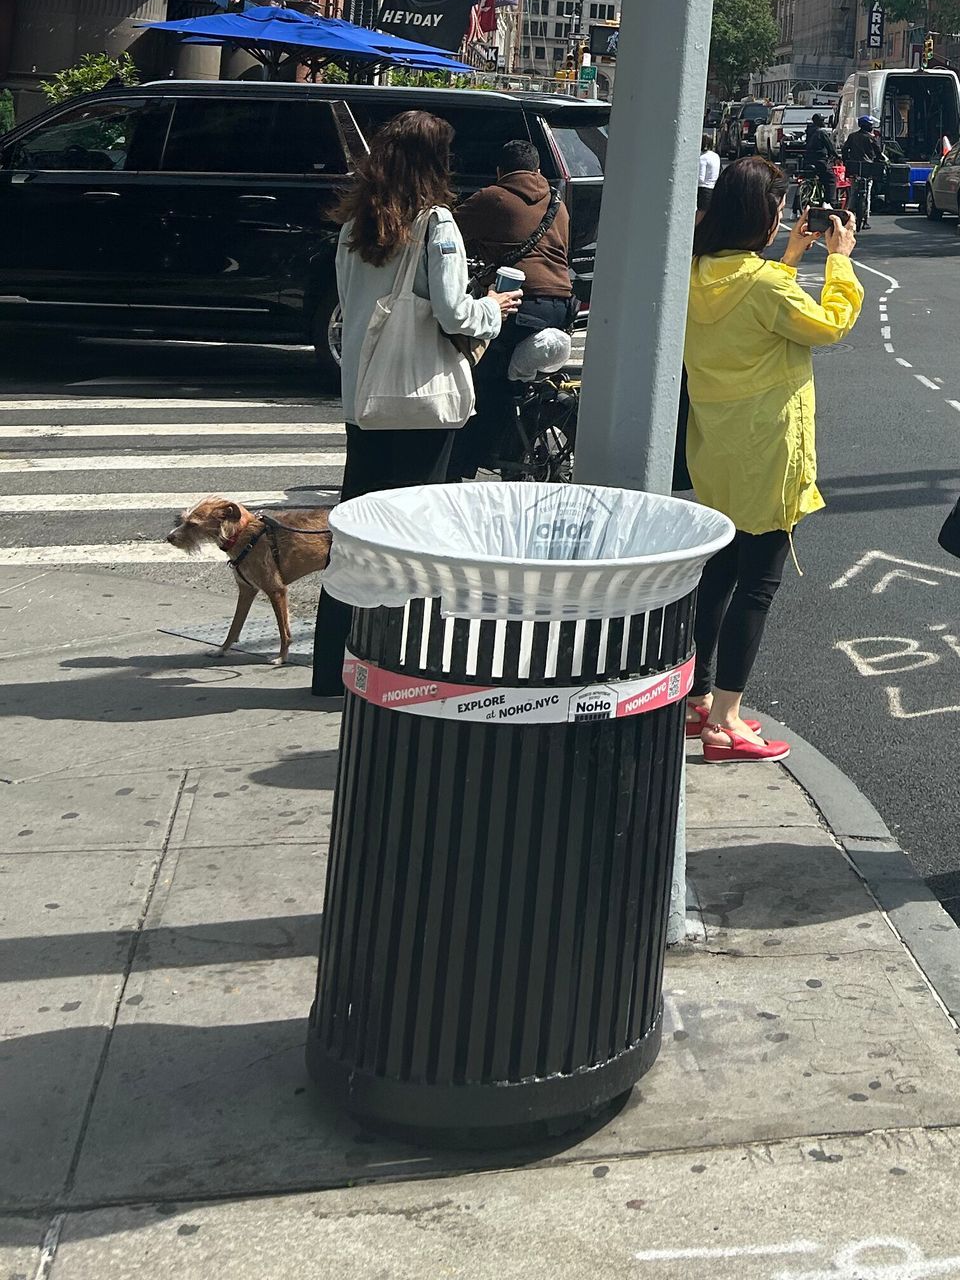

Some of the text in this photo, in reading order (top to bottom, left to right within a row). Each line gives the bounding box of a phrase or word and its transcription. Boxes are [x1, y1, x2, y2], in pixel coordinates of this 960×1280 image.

[381, 9, 444, 27] HEYDAY
[871, 0, 883, 35] ARK
[382, 684, 438, 703] #NOHONYC
[624, 683, 667, 714] NOHO.NYC
[457, 695, 506, 714] EXPLORE
[485, 709, 496, 719] at
[498, 694, 560, 719] NOHO.NYC
[576, 700, 611, 713] NoHo
